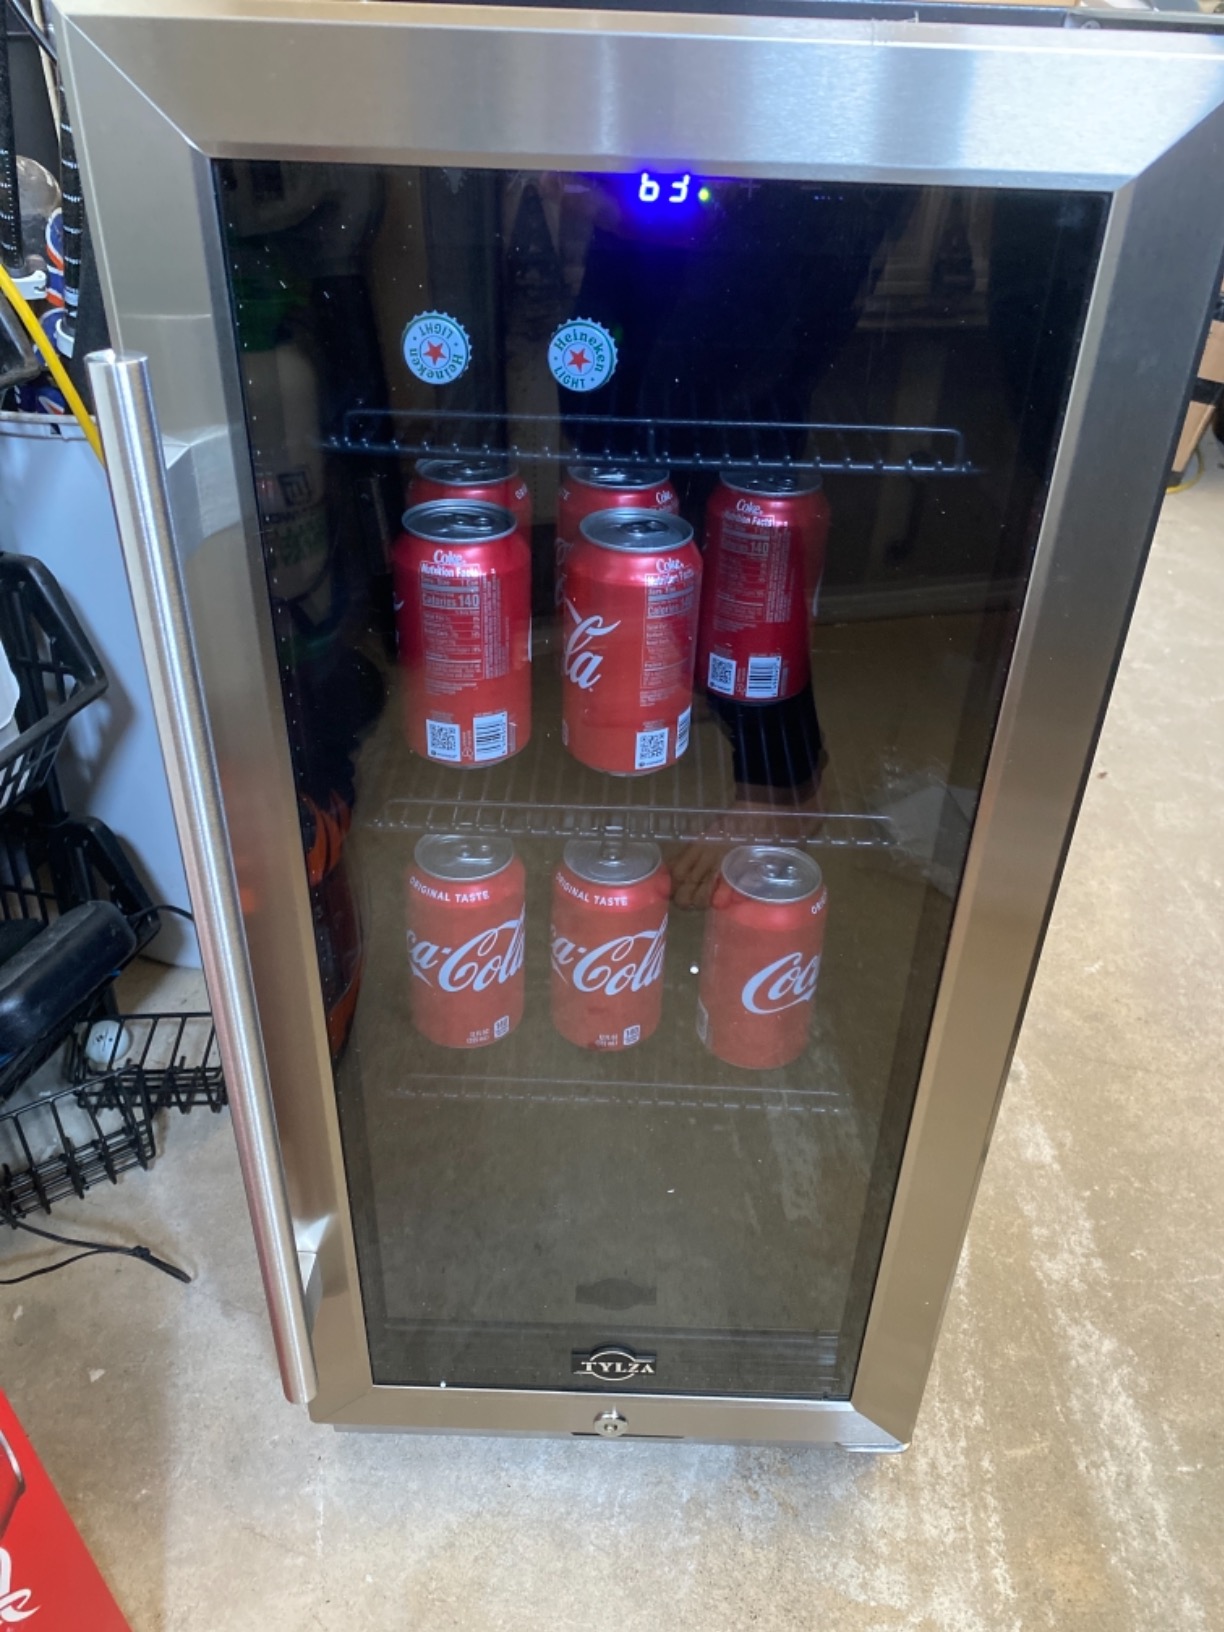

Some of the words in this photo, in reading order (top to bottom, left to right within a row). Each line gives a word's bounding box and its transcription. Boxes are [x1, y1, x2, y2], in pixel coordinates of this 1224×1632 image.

[418, 322, 455, 340] LIGHT
[554, 328, 605, 373] Heineken
[409, 347, 464, 380] Heineken
[553, 366, 587, 389] LIGHT
[736, 498, 763, 516] Coke
[433, 549, 466, 566] Coke
[459, 594, 479, 608] 140
[409, 875, 451, 902] ORIGINAL
[454, 890, 490, 903] TASTE
[593, 894, 628, 907] TASTE
[581, 1361, 654, 1373] TYLZA
